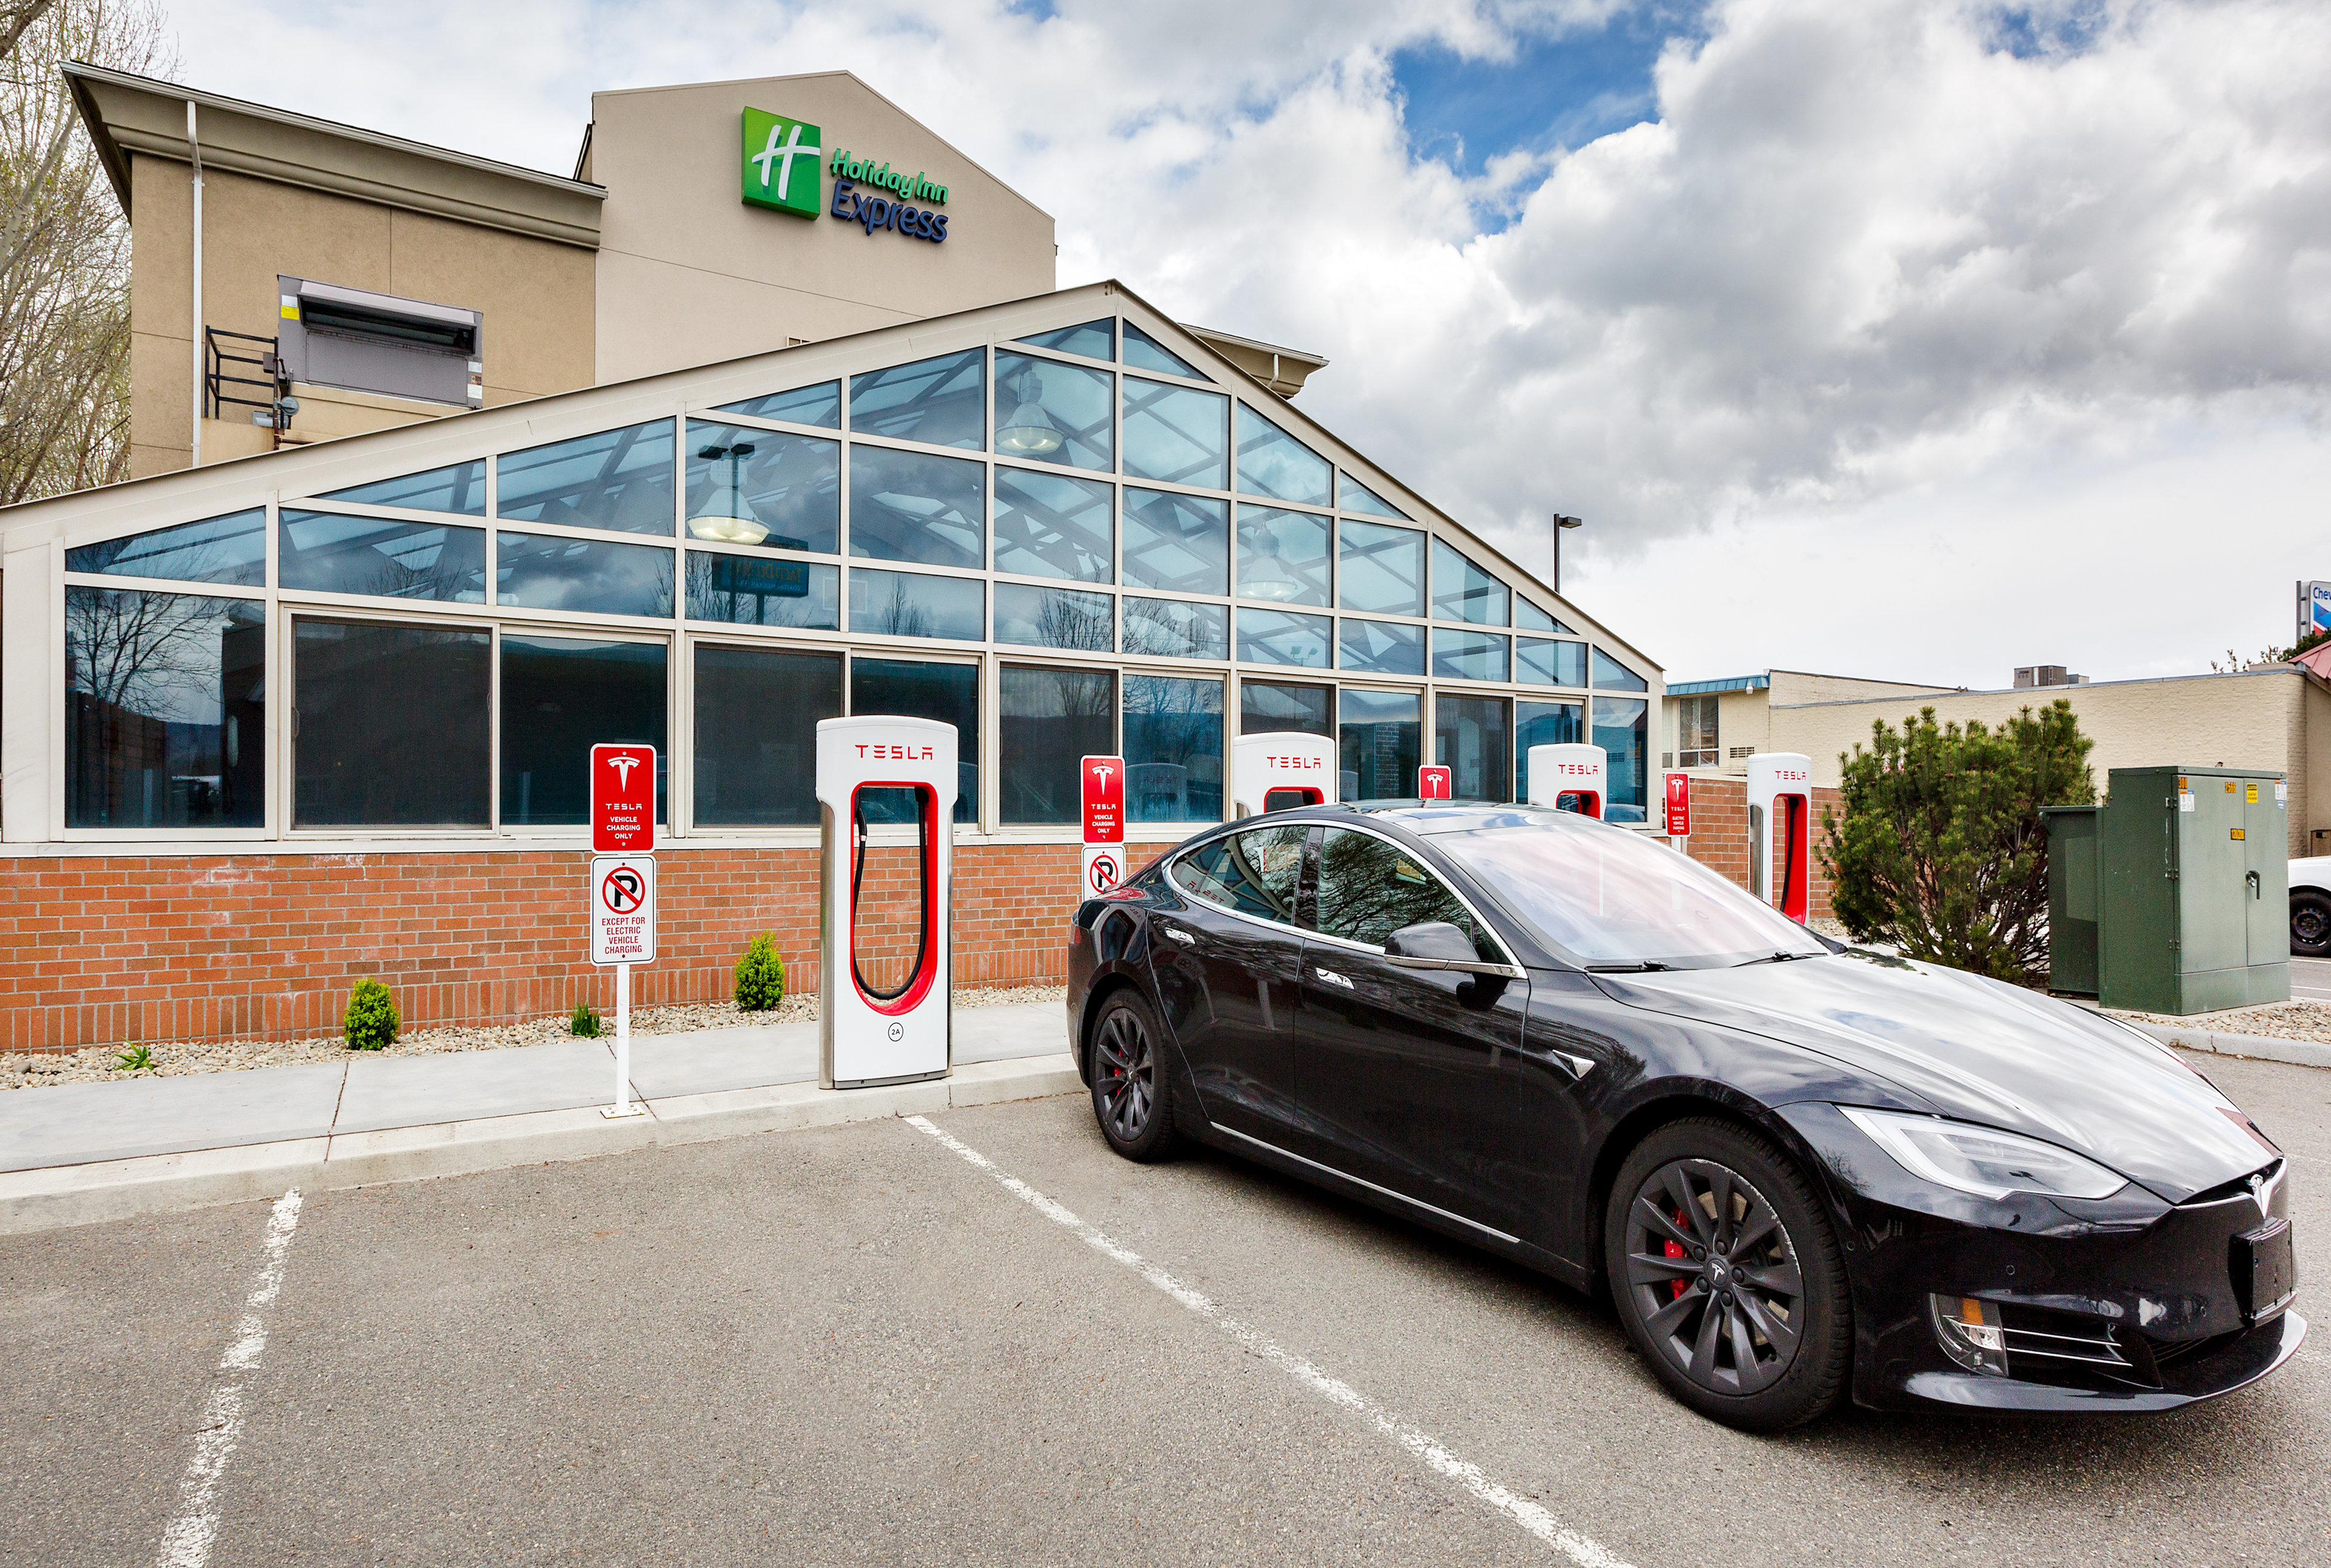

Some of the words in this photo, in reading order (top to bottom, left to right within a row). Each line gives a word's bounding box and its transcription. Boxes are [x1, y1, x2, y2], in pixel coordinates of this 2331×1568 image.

[830, 148, 915, 202] Holiday
[914, 172, 949, 206] Inn
[830, 179, 948, 243] Express
[855, 745, 933, 761] TESLA
[1266, 756, 1321, 769] TESLA
[1558, 764, 1598, 775] TESLA
[1775, 770, 1807, 781] TESLA
[1098, 861, 1113, 888] P
[614, 875, 637, 908] P
[602, 917, 629, 926] EXCEPT
[606, 926, 641, 935] ELECTRIC
[608, 935, 639, 945] VEHICLE
[605, 945, 642, 955] CHARGING
